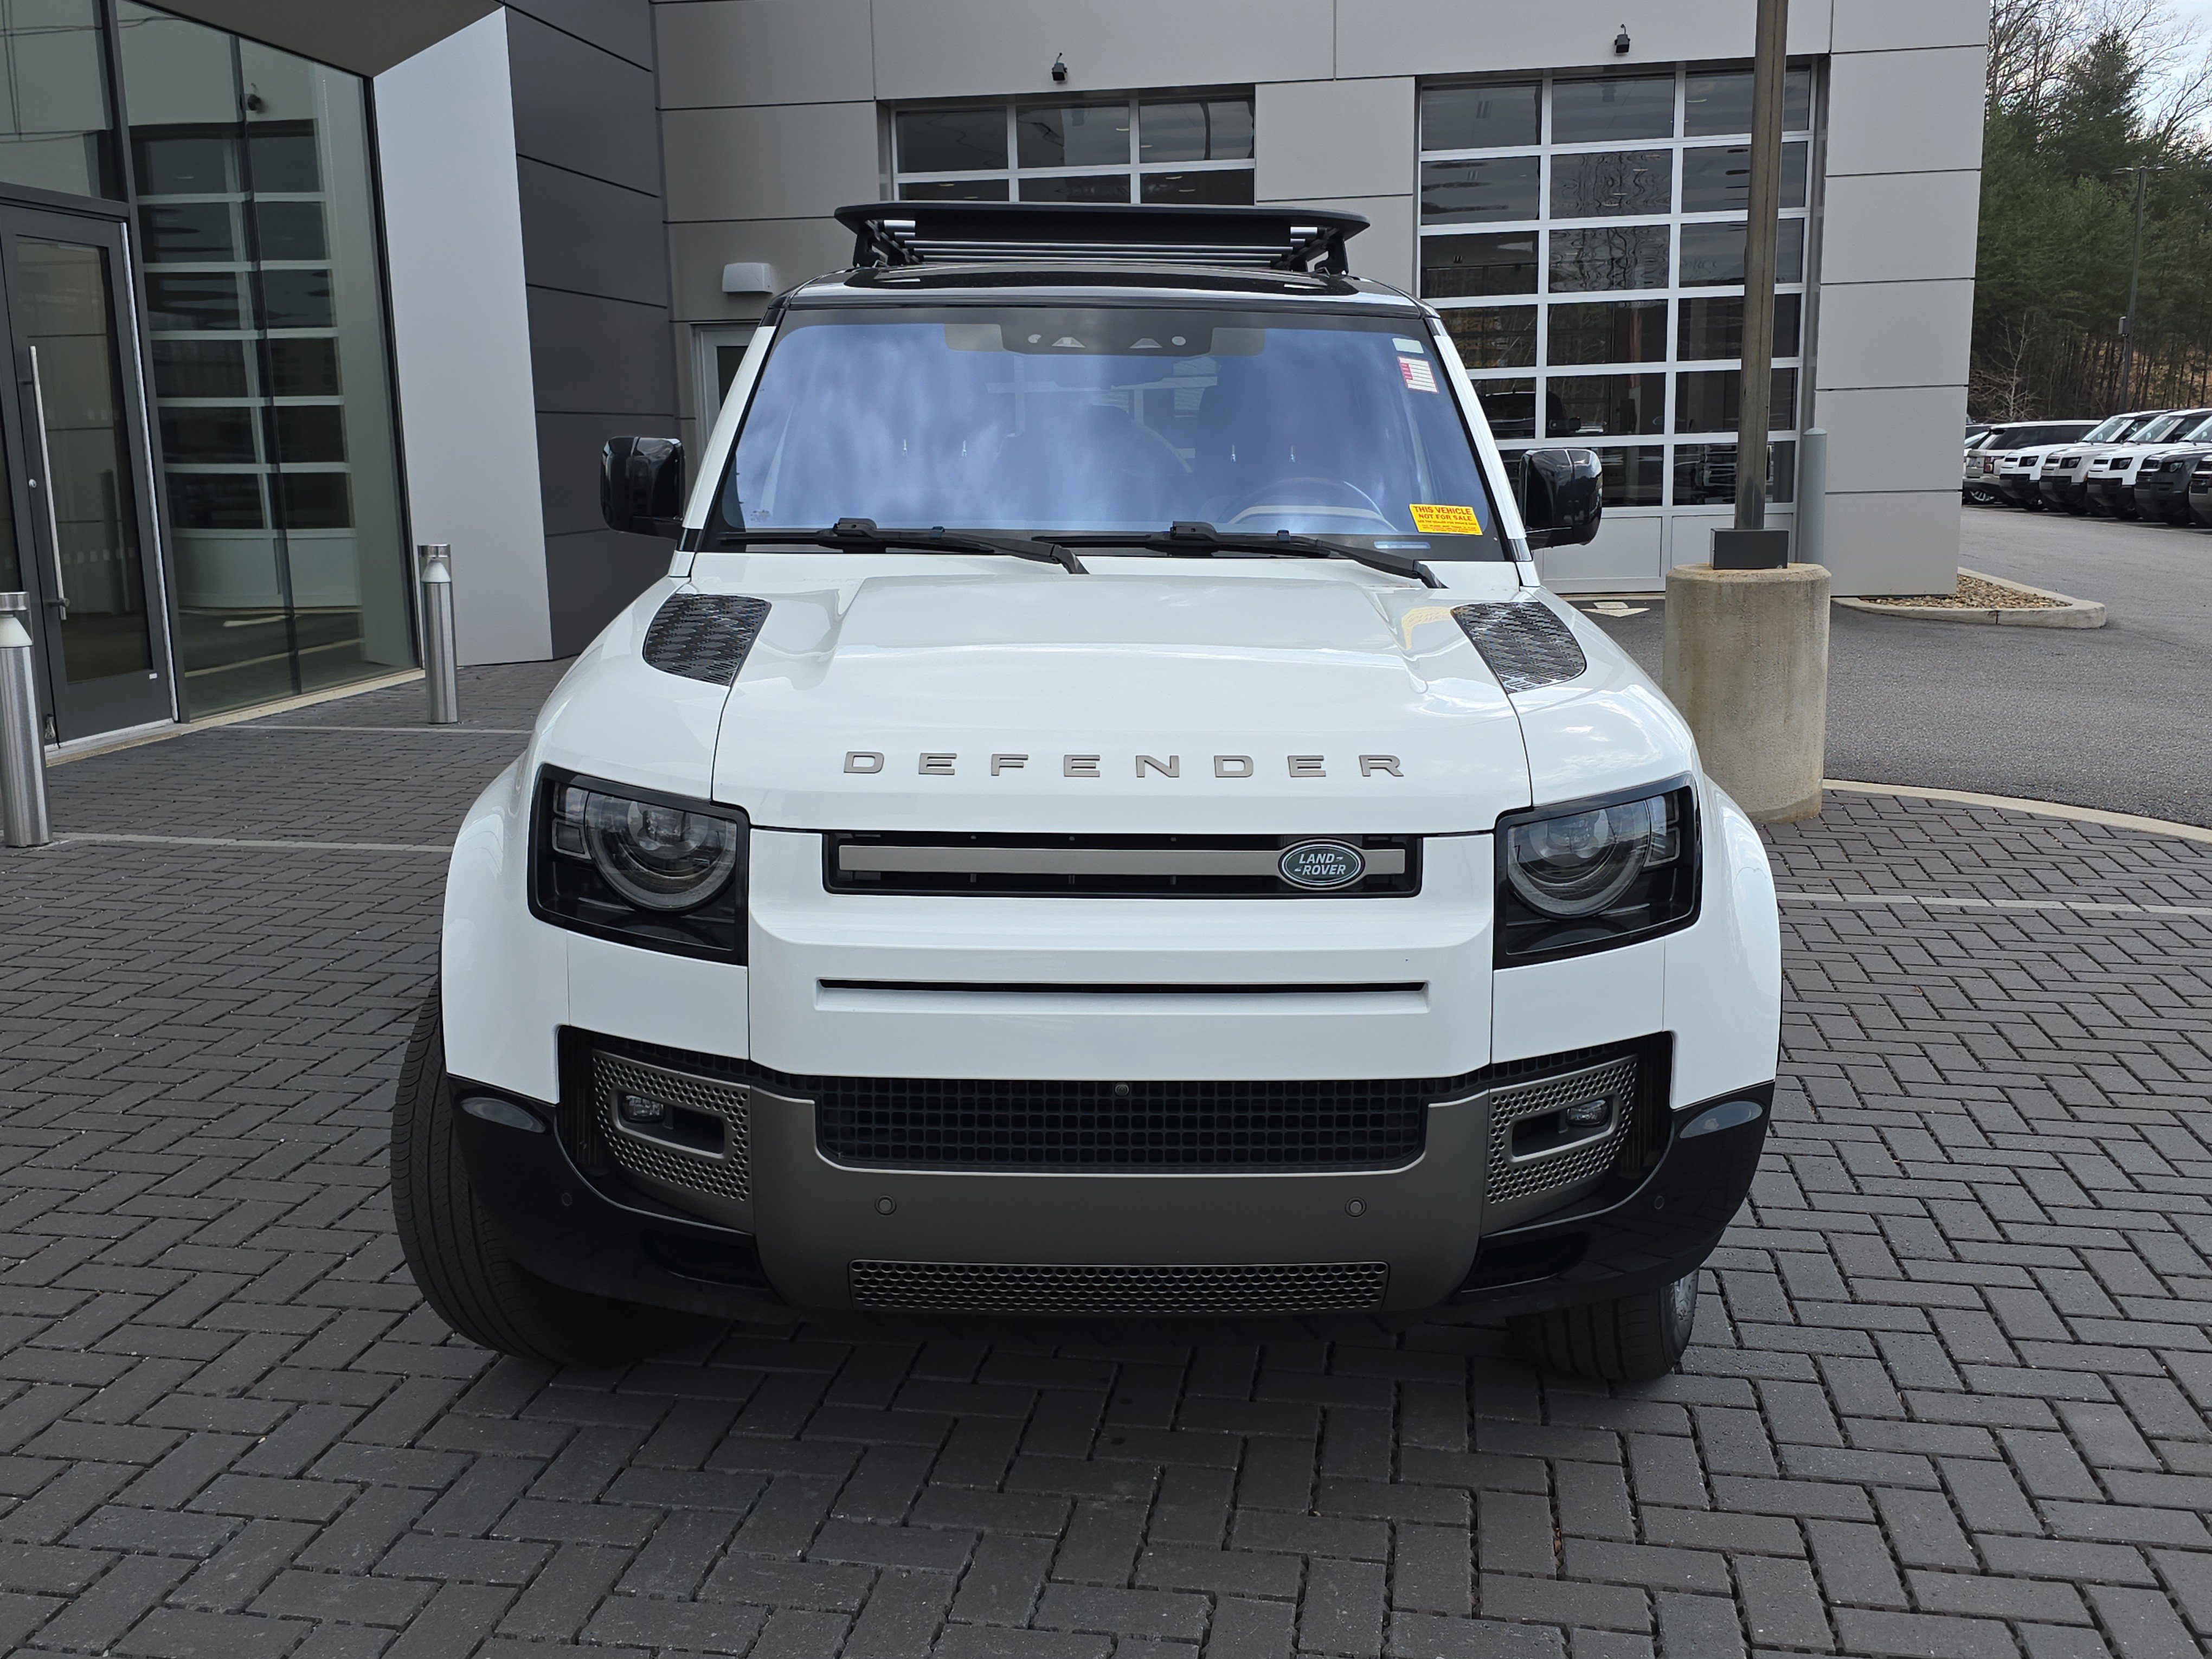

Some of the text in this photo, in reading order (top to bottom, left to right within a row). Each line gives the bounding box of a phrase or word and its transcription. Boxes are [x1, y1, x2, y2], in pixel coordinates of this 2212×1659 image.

[1435, 506, 1472, 515] VEHICLE
[844, 751, 1404, 777] DEFENDER
[1299, 853, 1335, 864] LAND
[1302, 864, 1346, 875] ROVER
